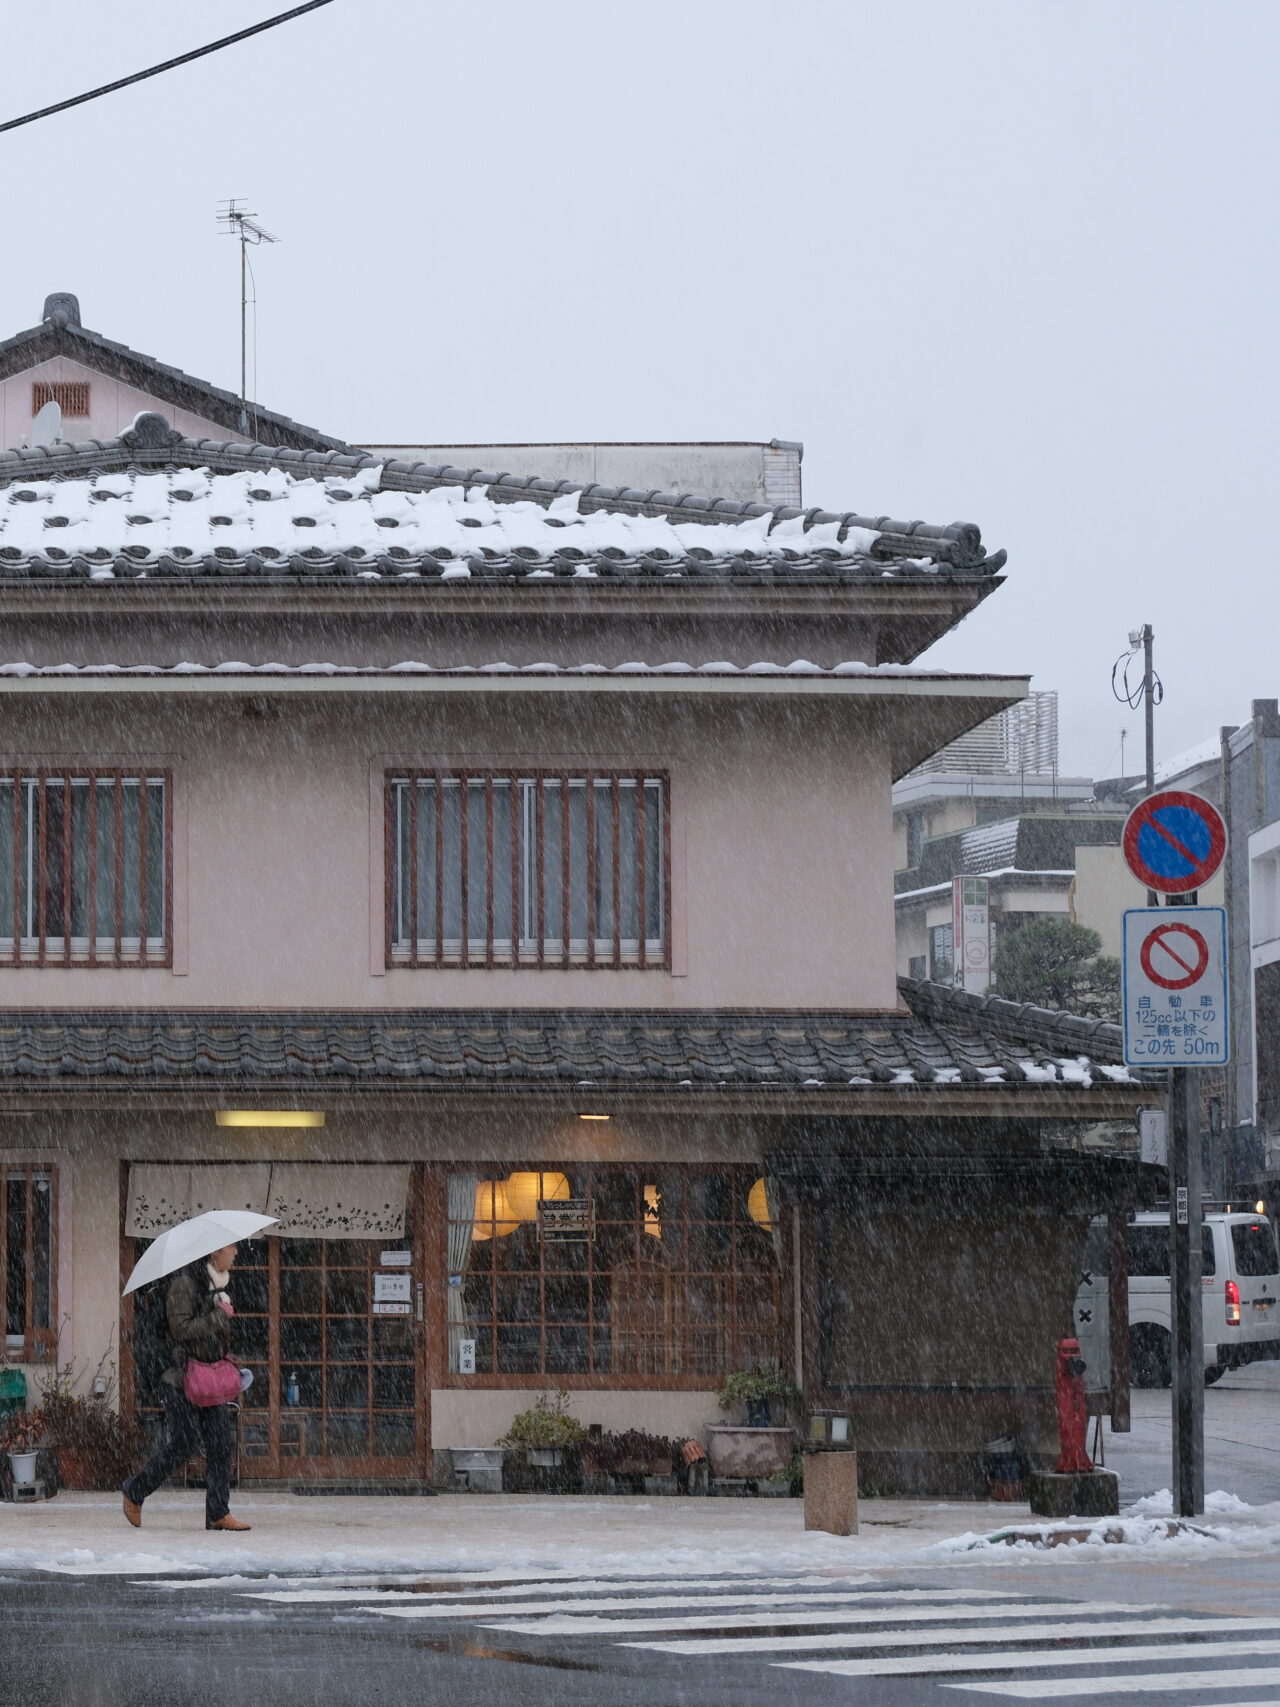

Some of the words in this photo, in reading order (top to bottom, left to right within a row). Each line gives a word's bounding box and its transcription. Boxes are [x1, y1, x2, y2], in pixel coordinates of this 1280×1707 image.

[1138, 994, 1214, 1009] 自動車
[1135, 1009, 1216, 1024] 125cc以下の
[1142, 1023, 1209, 1038] 二輪を除く
[1133, 1038, 1177, 1056] この先
[1183, 1037, 1220, 1056] 50m
[1177, 1188, 1188, 1222] 京都府
[462, 1344, 473, 1369] 営業
